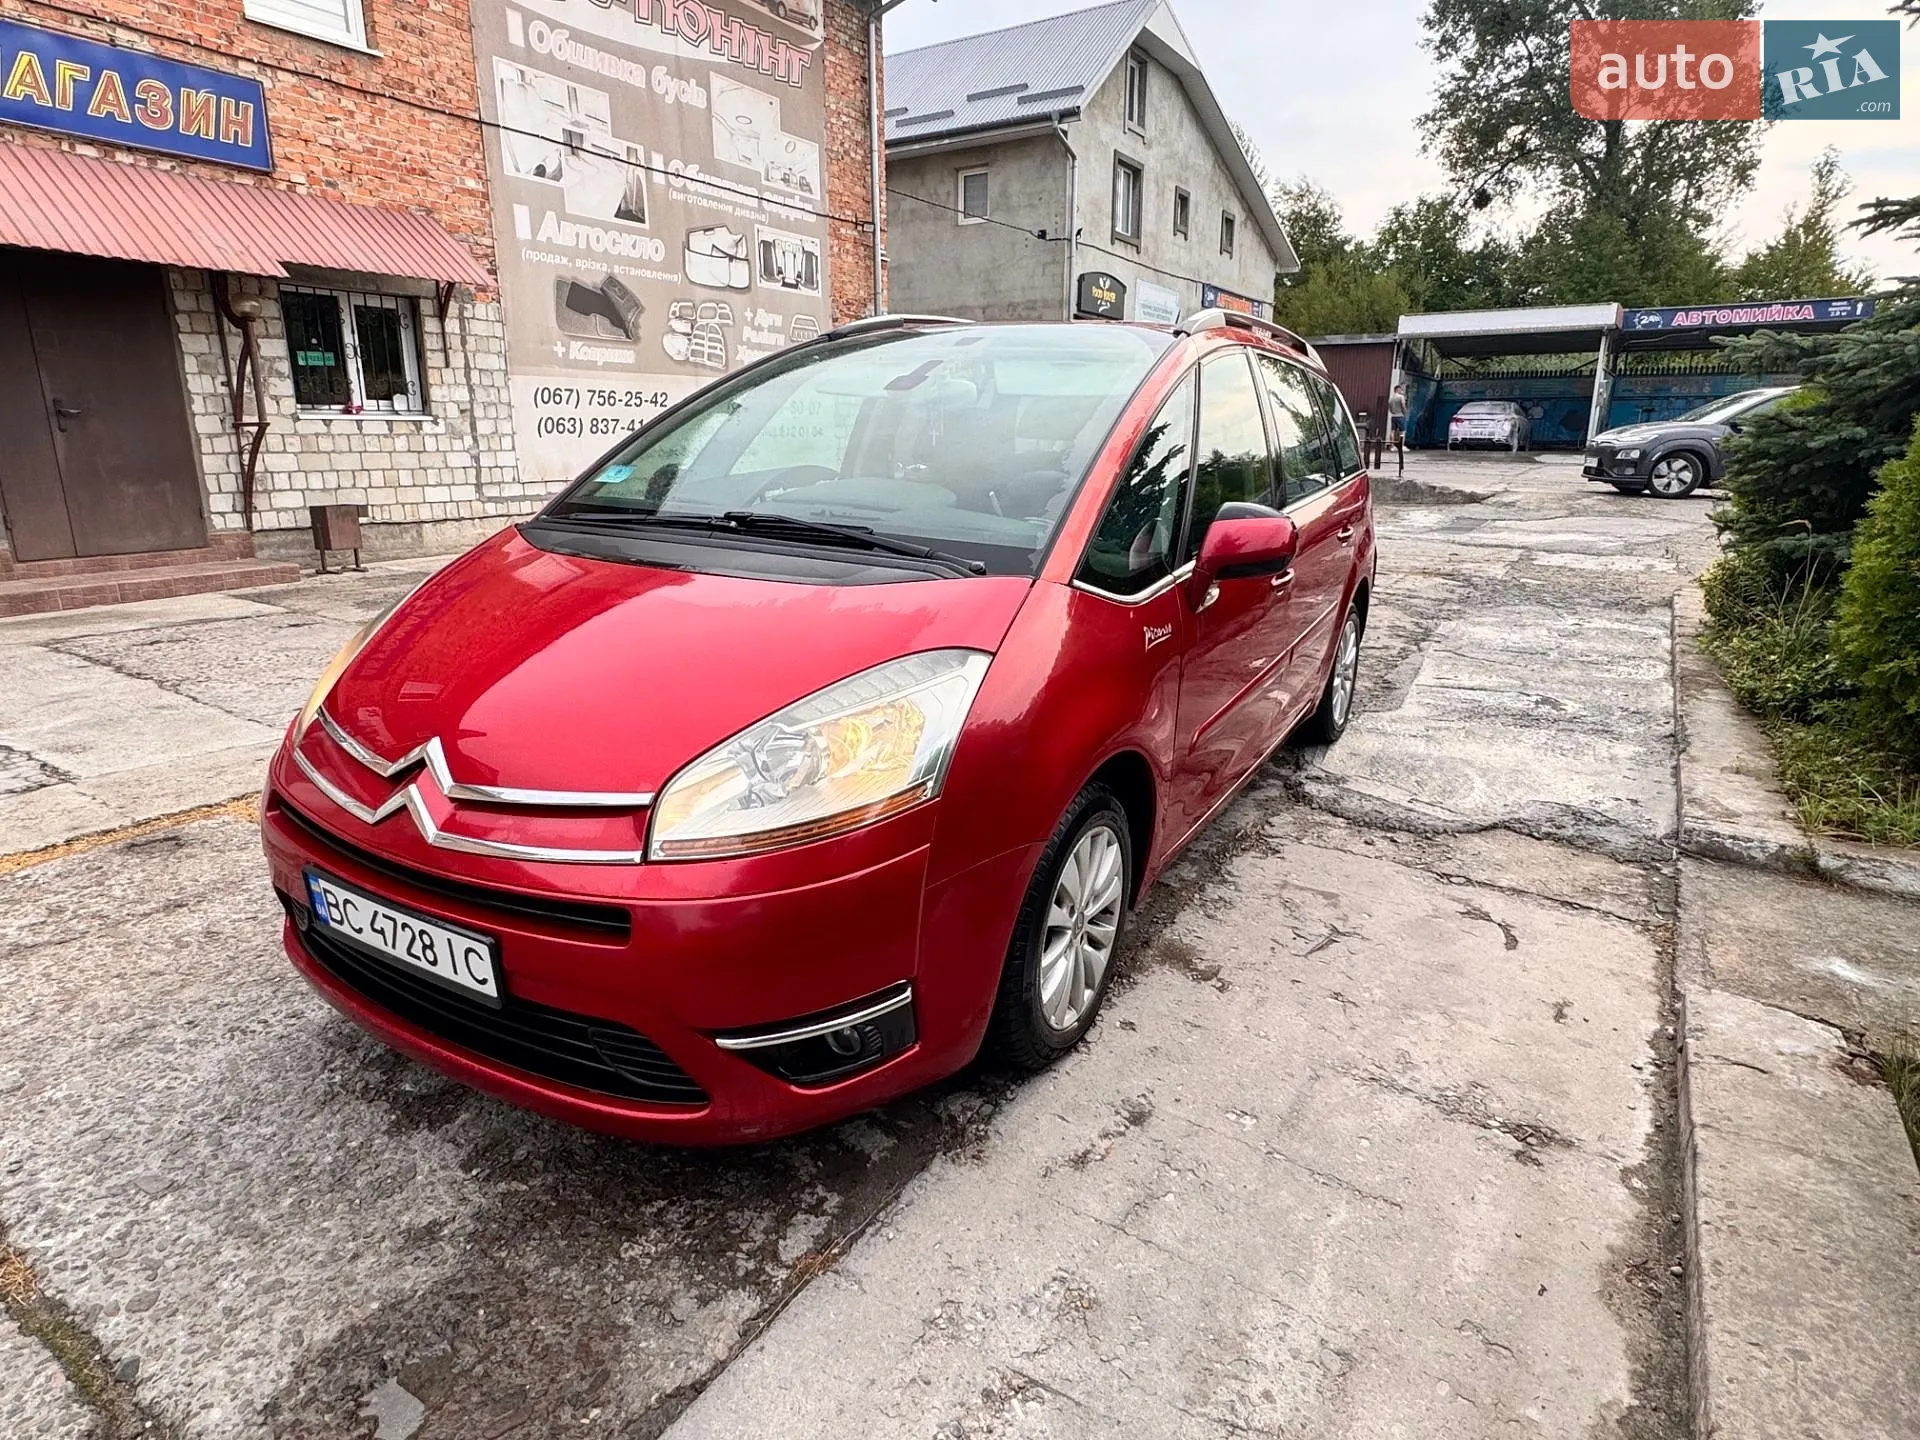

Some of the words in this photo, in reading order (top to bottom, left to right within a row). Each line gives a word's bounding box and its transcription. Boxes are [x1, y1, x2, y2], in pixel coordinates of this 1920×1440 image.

[528, 19, 647, 88] Обшивка
[652, 65, 707, 108] бусів
[0, 50, 254, 147] АГАЗИН
[536, 211, 665, 262] Автоскло
[521, 247, 572, 268] (продаж,
[575, 257, 611, 273] врізка,
[613, 265, 682, 285] встановлення)
[1671, 304, 1815, 326] АВТОМИЙКА
[533, 387, 580, 409] (067)
[587, 390, 668, 408] 756-25-42
[537, 417, 583, 437] (063)
[323, 886, 363, 935] BC
[370, 910, 438, 967] 4728
[447, 938, 488, 986] IC
